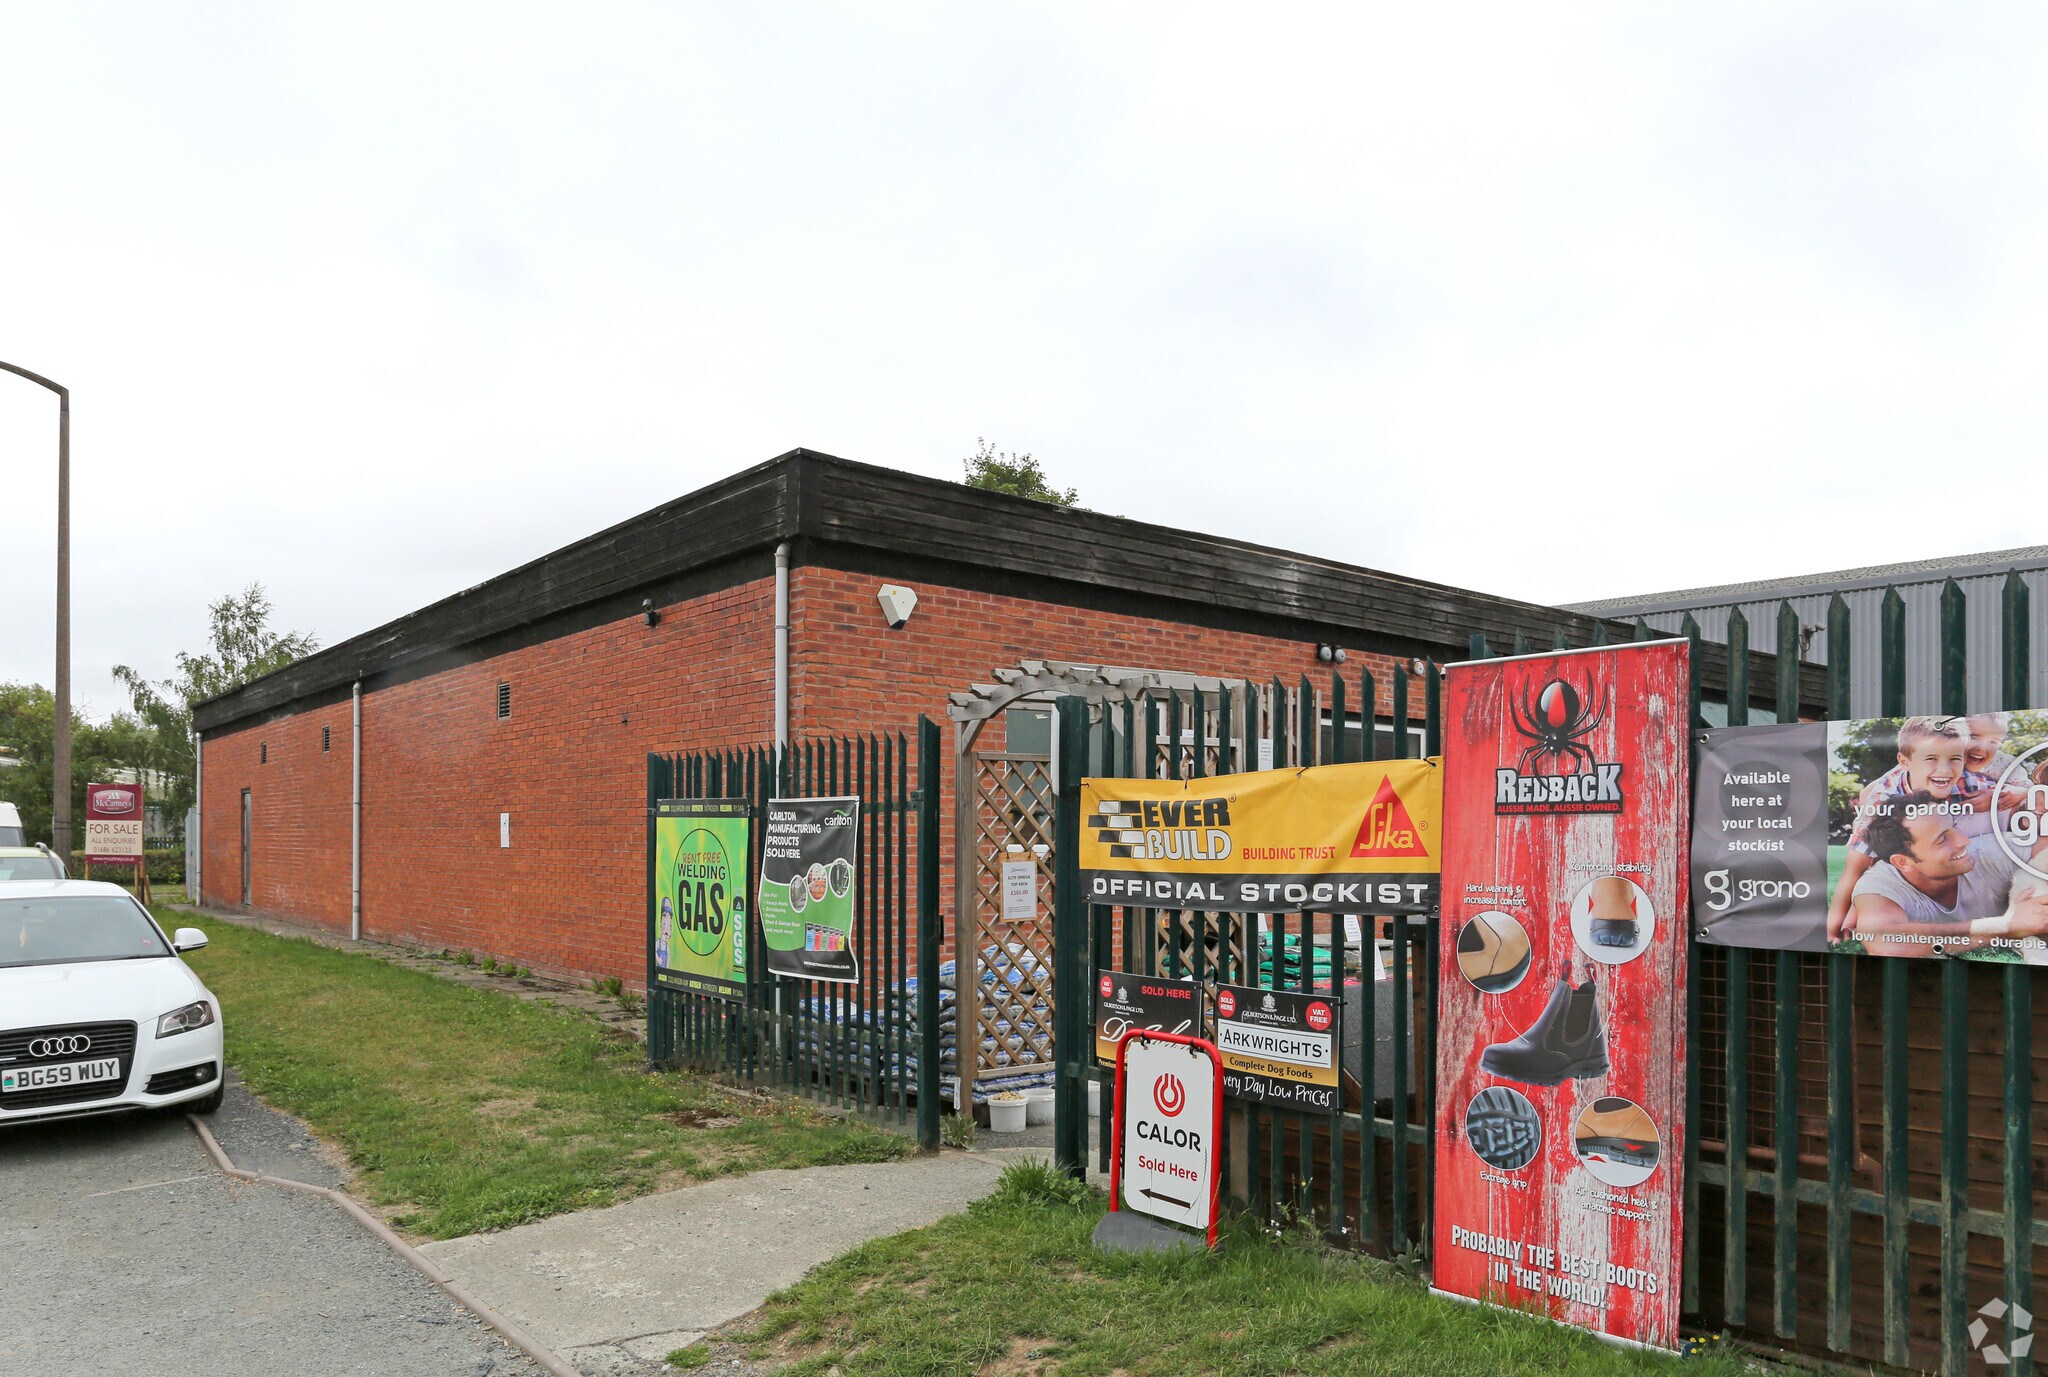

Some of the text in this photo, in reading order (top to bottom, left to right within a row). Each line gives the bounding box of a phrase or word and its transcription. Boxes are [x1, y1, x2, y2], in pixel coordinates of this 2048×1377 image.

[1496, 764, 1621, 803] REDBACK
[1723, 771, 1791, 785] Available
[95, 800, 132, 808] McCartneys
[1497, 803, 1621, 813] AUSSIE MADE. AUSSIE OWNED.
[1731, 794, 1782, 807] here at
[769, 811, 797, 821] CARLTON
[1142, 797, 1232, 828] EVER
[1854, 800, 1974, 821] your garden
[89, 824, 139, 834] FOR SALE
[768, 823, 821, 834] MANUFACTURING
[824, 815, 852, 826] carlton
[1359, 802, 1415, 850] Sika
[1722, 817, 1793, 832] your local
[767, 836, 800, 846] PRODUCTS
[1145, 828, 1233, 861] BUILD
[1727, 839, 1785, 851] stockist
[682, 852, 721, 864] RENT FREE
[766, 847, 800, 859] SOLD HERE
[1242, 846, 1336, 860] BUILDING TRUST
[677, 863, 726, 880] WELDING
[1570, 860, 1652, 875] Reinforcing stability
[1092, 877, 1429, 904] OFFICIAL STOCKIST
[1465, 883, 1523, 896] Hard wearing &
[1738, 879, 1811, 901] grono
[678, 879, 724, 935] GAS
[1463, 895, 1527, 906] increased comfort
[733, 913, 743, 965] SGS
[1851, 930, 2047, 950] low maintenance durable
[1141, 985, 1191, 999] SOLD HERE
[1220, 996, 1234, 1004] SOLD
[1220, 1003, 1234, 1011] HERE
[1309, 1016, 1328, 1024] FREE
[1223, 1028, 1322, 1058] ARKWRIGHTS
[17, 1060, 116, 1088] BG59 WUY
[1229, 1056, 1313, 1079] Complete Dog Foods
[1222, 1075, 1241, 1095] very
[1244, 1076, 1265, 1100] Day
[1268, 1078, 1292, 1098] Low
[1136, 1120, 1201, 1153] CALOR
[1138, 1155, 1198, 1182] Sold Here
[1480, 1170, 1528, 1190] Extreme grip
[1575, 1187, 1658, 1210] Air cushioned heel &
[1581, 1200, 1652, 1222] anatomic support
[1451, 1224, 1658, 1295] PROBABLY THE BEST BOOTS
[1494, 1261, 1607, 1309] IN THE WORLD!
